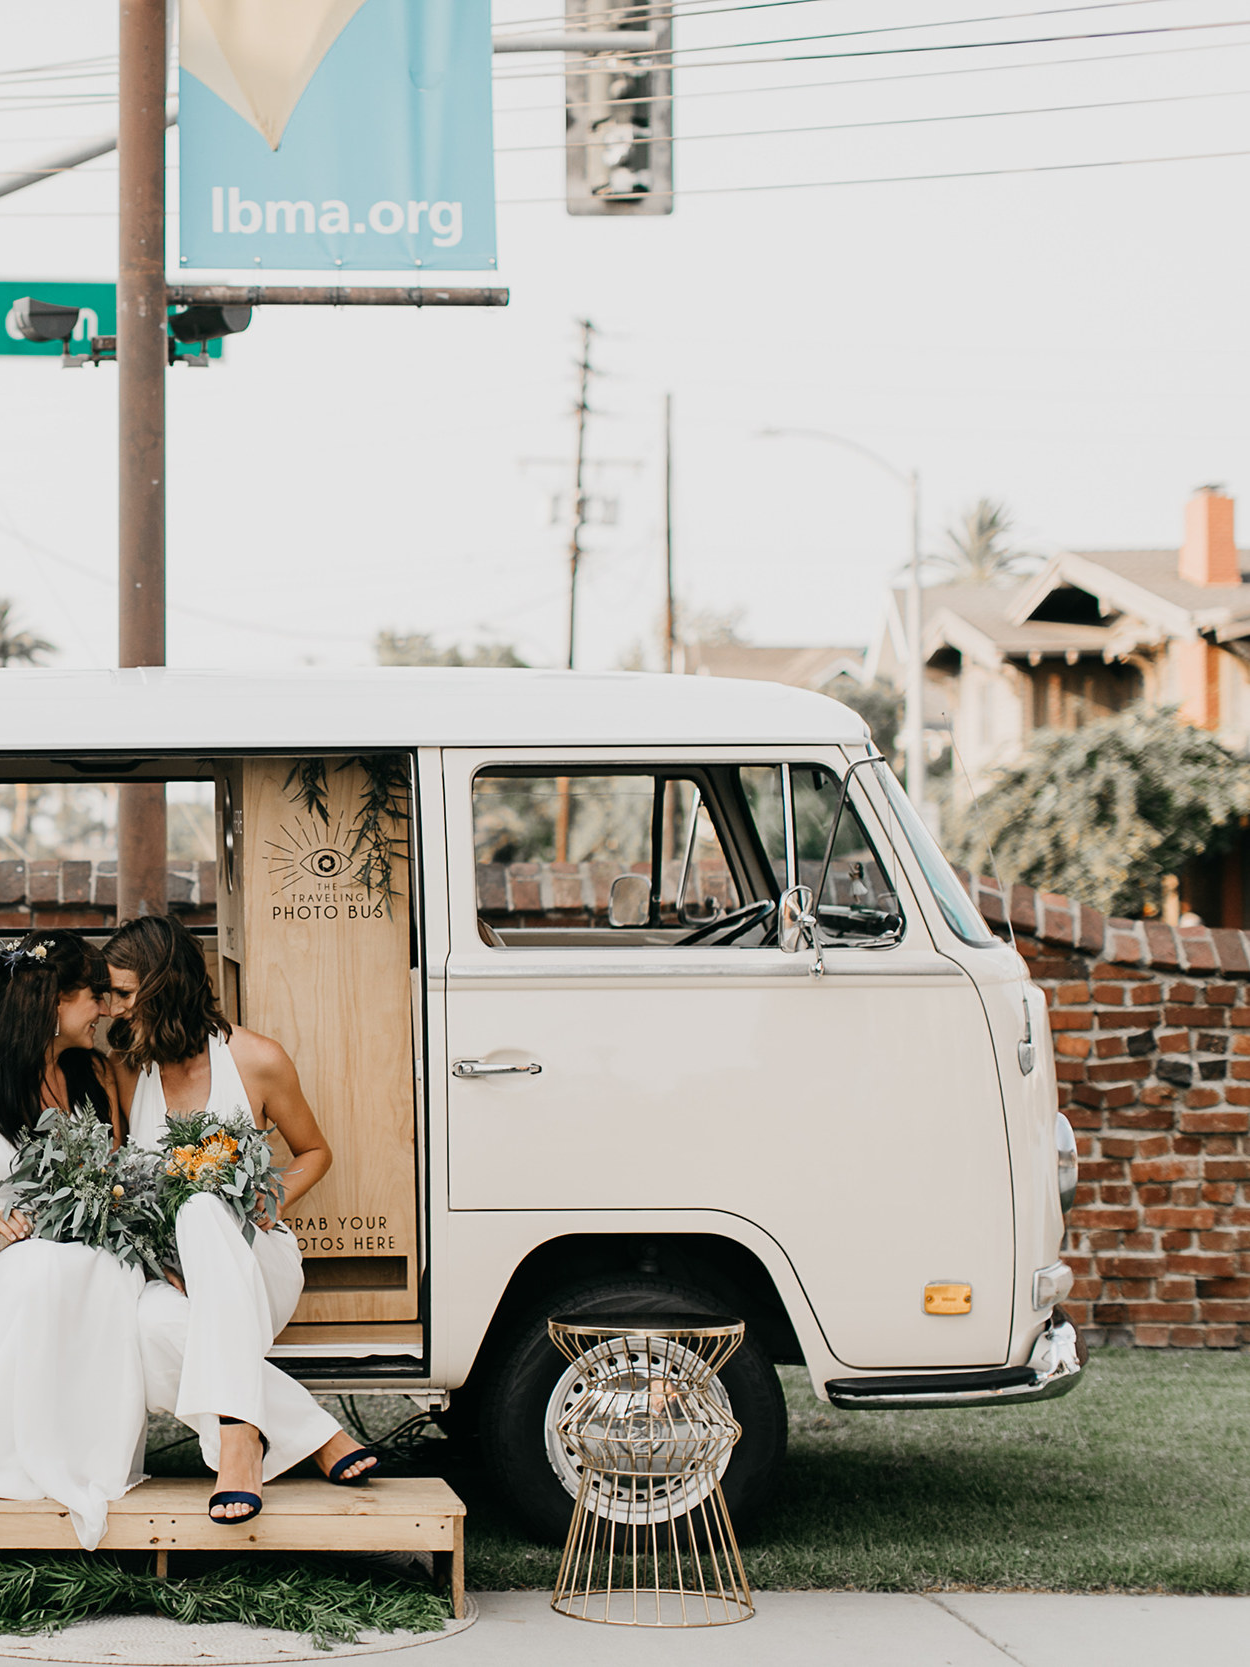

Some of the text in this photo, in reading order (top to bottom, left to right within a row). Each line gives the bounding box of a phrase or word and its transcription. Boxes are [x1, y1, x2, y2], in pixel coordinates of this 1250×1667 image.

[211, 186, 463, 248] lbma.org
[317, 882, 338, 891] THE
[291, 893, 364, 903] TRAVELING
[272, 905, 383, 920] PHOTO BUS
[282, 1216, 387, 1231] GRAB YOUR
[296, 1236, 396, 1251] OTOS HERE
